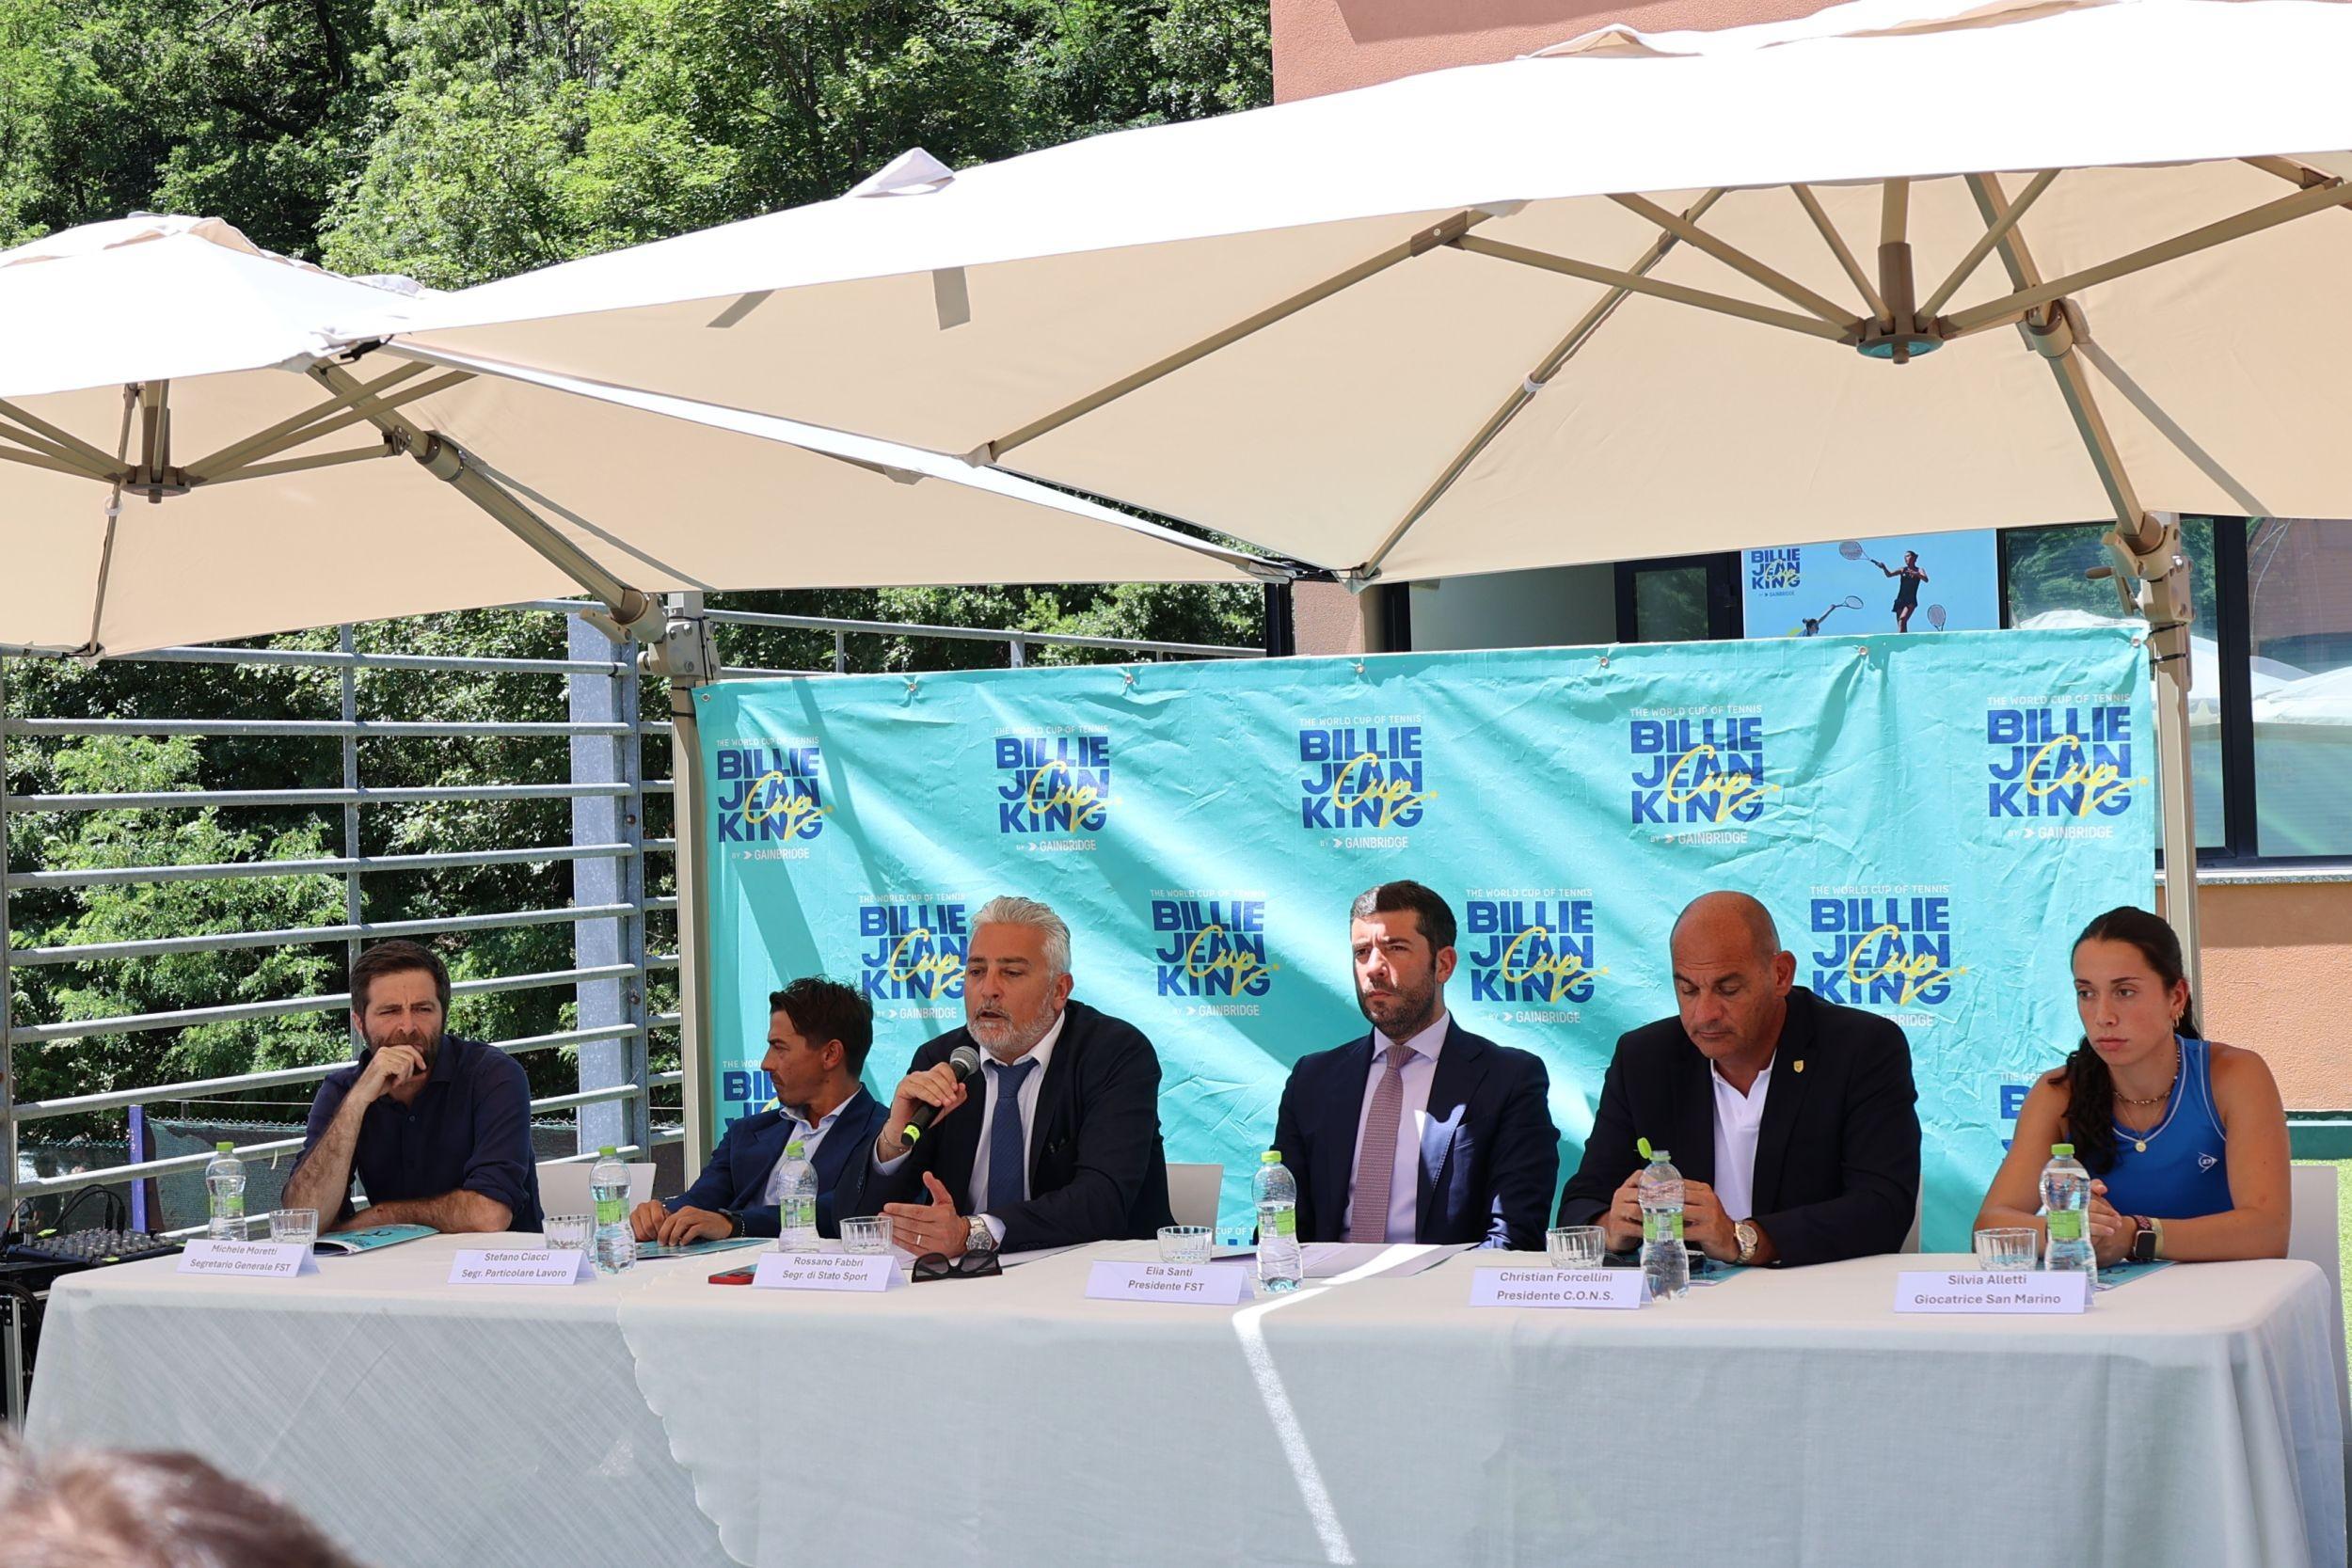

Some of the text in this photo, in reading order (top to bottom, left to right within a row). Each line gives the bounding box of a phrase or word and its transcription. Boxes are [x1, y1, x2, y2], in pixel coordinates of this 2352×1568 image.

[1751, 548, 1800, 563] BILLIE
[1752, 562, 1800, 576] JEAN
[1752, 575, 1801, 590] KING
[1630, 705, 1762, 717] THE WORLD CUP OF TENNIS
[1987, 693, 2131, 705] THE WORLD CUP OF TENNIS
[1065, 725, 1075, 734] OF
[1079, 724, 1108, 733] TENNIS
[1299, 718, 1316, 726] THE
[1319, 717, 1351, 726] WORLD
[1389, 715, 1422, 723] TENNIS
[1630, 718, 1762, 753] BILLIE
[1987, 706, 2131, 744] BILLIE
[717, 738, 729, 747] THE
[731, 738, 759, 747] WORLD
[762, 737, 775, 746] CUP
[995, 736, 1109, 768] BILLIE
[1299, 726, 1422, 762] BILLIE
[717, 748, 819, 780] BILLIE
[1631, 752, 1764, 788] JEAN
[1989, 743, 2131, 781] JEAN
[2026, 735, 2139, 818] Cup
[998, 768, 1109, 800] JEAN
[1301, 761, 1422, 795] JEAN
[1333, 752, 1428, 829] Cup
[1666, 744, 1772, 824] Cup
[719, 778, 821, 811] JEAN
[743, 771, 826, 842] Cup
[1027, 760, 1113, 833] Cup
[1631, 788, 1764, 824] KING
[1989, 781, 2132, 817] KING
[719, 810, 823, 843] KING
[999, 800, 1107, 833] KING
[1302, 795, 1423, 829] KING
[1040, 840, 1096, 851] GAINBRIDGE
[1345, 836, 1408, 848] GAINBRIDGE
[1678, 832, 1748, 844] GAINBRIDGE
[2039, 826, 2114, 839] GAINBRIDGE
[755, 847, 809, 860] GAINBRIDGE
[859, 895, 874, 903] THE
[877, 894, 904, 902] WORLD
[907, 894, 921, 902] CUP
[937, 893, 965, 901] TENNIS
[1151, 889, 1165, 897] THE
[1810, 885, 1949, 895] THE WORLD CUP OF TENNIS
[860, 904, 967, 936] BILLIE
[1152, 900, 1264, 931] BILLIE
[1467, 901, 1594, 933] BILLIE
[1811, 897, 1949, 932] BILLIE
[862, 936, 968, 968] JEAN
[1155, 932, 1266, 964] JEAN
[1187, 925, 1270, 997] Cup
[1470, 935, 1594, 968] JEAN
[1812, 934, 1950, 969] JEAN
[889, 928, 965, 1001] Cup
[1158, 964, 1270, 996] KING
[1503, 927, 1600, 1004] Cup
[1849, 924, 1956, 1006] Cup
[862, 968, 964, 999] KING
[1470, 969, 1595, 1003] KING
[1813, 970, 1951, 1005] KING
[899, 1007, 956, 1019] GAINBRIDGE
[1199, 1005, 1260, 1016] GAINBRIDGE
[1516, 1011, 1581, 1023] GAINBRIDGE
[723, 1070, 777, 1101] BIL
[211, 1244, 278, 1255] Michele Moretti
[485, 1253, 549, 1261] Stefano Ciacci
[794, 1257, 864, 1267] Rossano Fabbri
[190, 1259, 291, 1272] Segretario Generale FST
[462, 1269, 483, 1279] Segr.
[485, 1269, 534, 1277] Particolare
[783, 1270, 867, 1282] Segr. di Stato Sport
[1146, 1266, 1193, 1276] Elia Santi
[1500, 1272, 1613, 1282] Christian Forcellini
[1948, 1275, 2027, 1285] Silvia Alletti
[1129, 1280, 1204, 1291] Presidente FST
[1497, 1291, 1613, 1301] Presidente C.O.N.S.
[1915, 1294, 2061, 1305] Giocatrice San Marino
